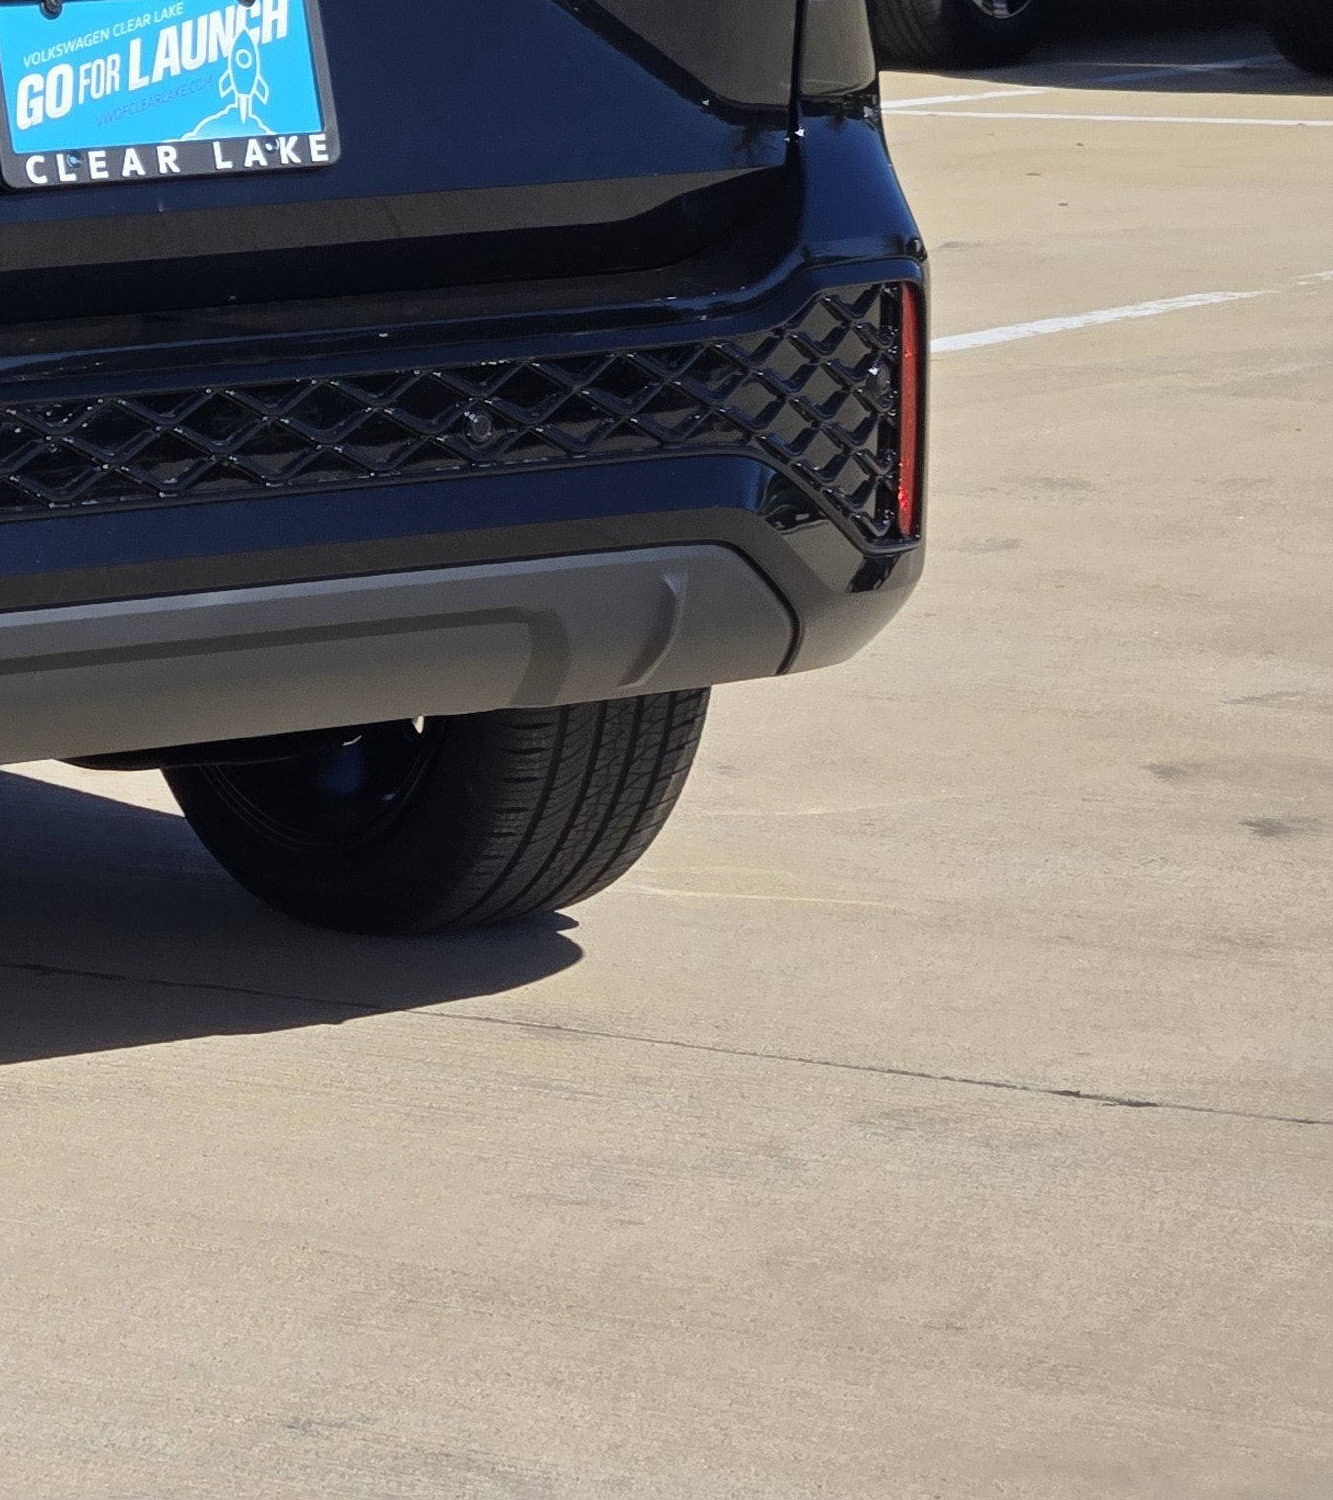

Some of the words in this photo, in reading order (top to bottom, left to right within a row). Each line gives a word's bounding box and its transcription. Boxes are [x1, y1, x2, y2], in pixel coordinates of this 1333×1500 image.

[23, 28, 110, 68] VOLKSWAGEN
[112, 17, 152, 37] CLEAR
[153, 1, 184, 23] LAKE
[16, 62, 74, 131] GO
[78, 52, 121, 105] FOR
[95, 74, 214, 127] VWOFCLEARLAKE.COM
[25, 144, 181, 185] CLEAR
[213, 132, 329, 171] LAKE
